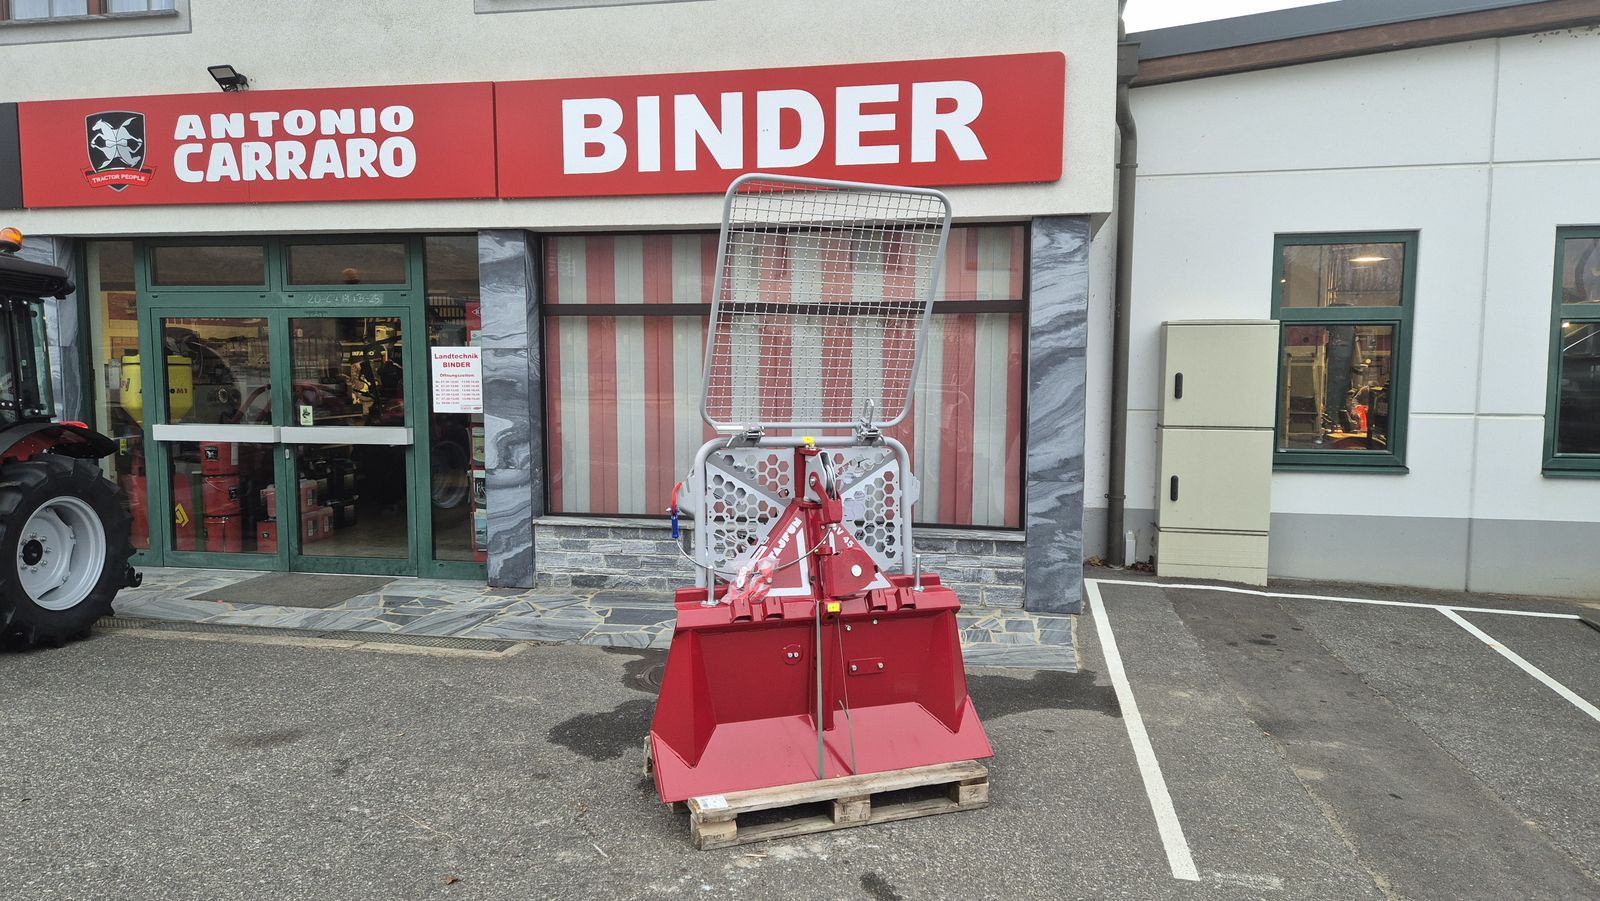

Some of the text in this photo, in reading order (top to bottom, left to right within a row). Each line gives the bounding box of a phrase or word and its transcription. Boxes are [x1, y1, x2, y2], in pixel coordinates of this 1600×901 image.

[173, 105, 415, 140] ANTONIO
[562, 80, 988, 175] BINDER
[92, 174, 146, 183] TRACTOR PEOPLE
[173, 136, 417, 183] CARRARO
[767, 516, 803, 560] TAJFUN
[842, 536, 855, 548] 45
